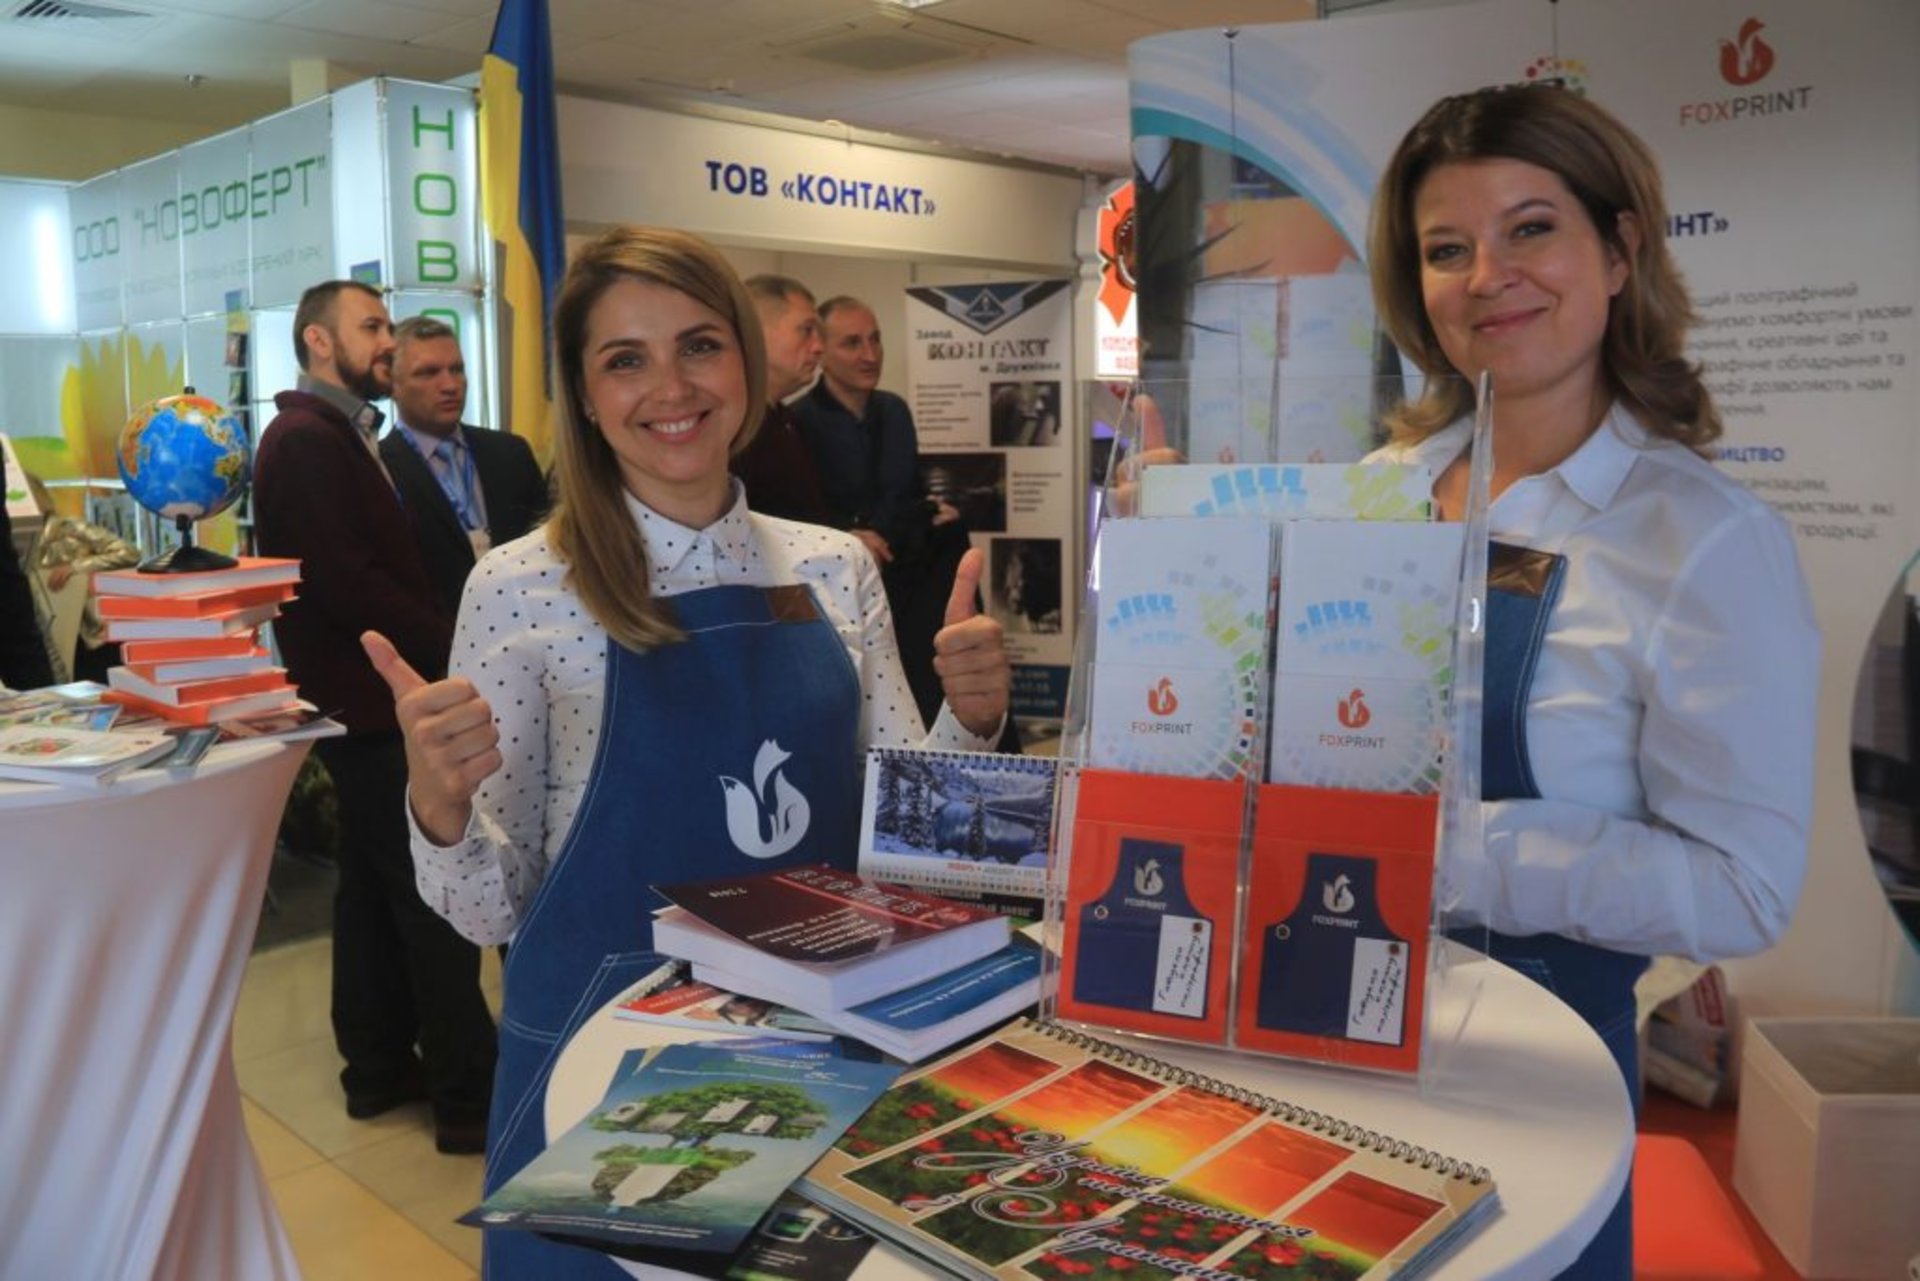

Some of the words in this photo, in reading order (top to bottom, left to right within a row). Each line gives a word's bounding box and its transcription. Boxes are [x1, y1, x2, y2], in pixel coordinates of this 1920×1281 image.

[1680, 86, 1813, 126] FOXPRINT
[706, 160, 768, 196] ТОВ
[781, 173, 936, 215] «КОНТАКТ»
[75, 217, 120, 262] ООО
[134, 155, 326, 244] "НОВОФЕРТ"
[1666, 211, 1729, 238] ІНТ»
[1759, 309, 1851, 326] комфортні
[1857, 306, 1913, 324] умови
[1869, 330, 1888, 343] та
[927, 338, 1051, 361] КОНТАКТ
[1776, 353, 1881, 371] обладнання
[1886, 353, 1905, 366] та
[1857, 377, 1893, 392] нам
[1131, 722, 1192, 735] FOXPRINT
[1319, 734, 1386, 749] FOXPRINT
